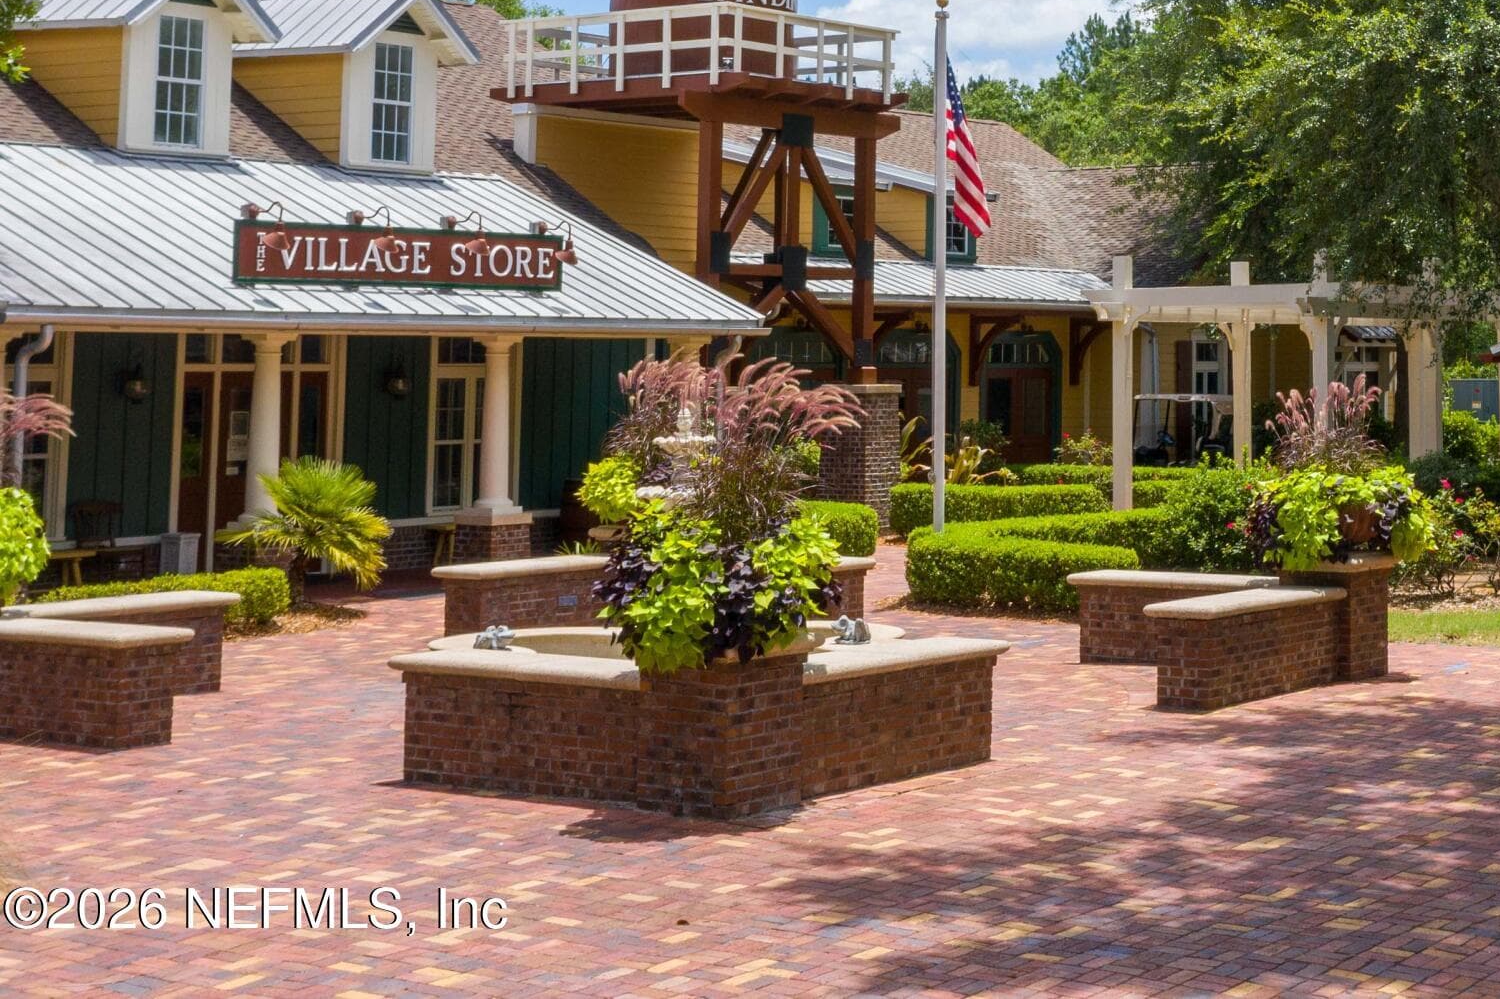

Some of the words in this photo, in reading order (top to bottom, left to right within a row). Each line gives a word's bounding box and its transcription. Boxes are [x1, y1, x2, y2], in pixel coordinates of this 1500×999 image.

[256, 232, 266, 272] THE
[280, 236, 431, 274] VILLAGE
[450, 243, 554, 279] STORE
